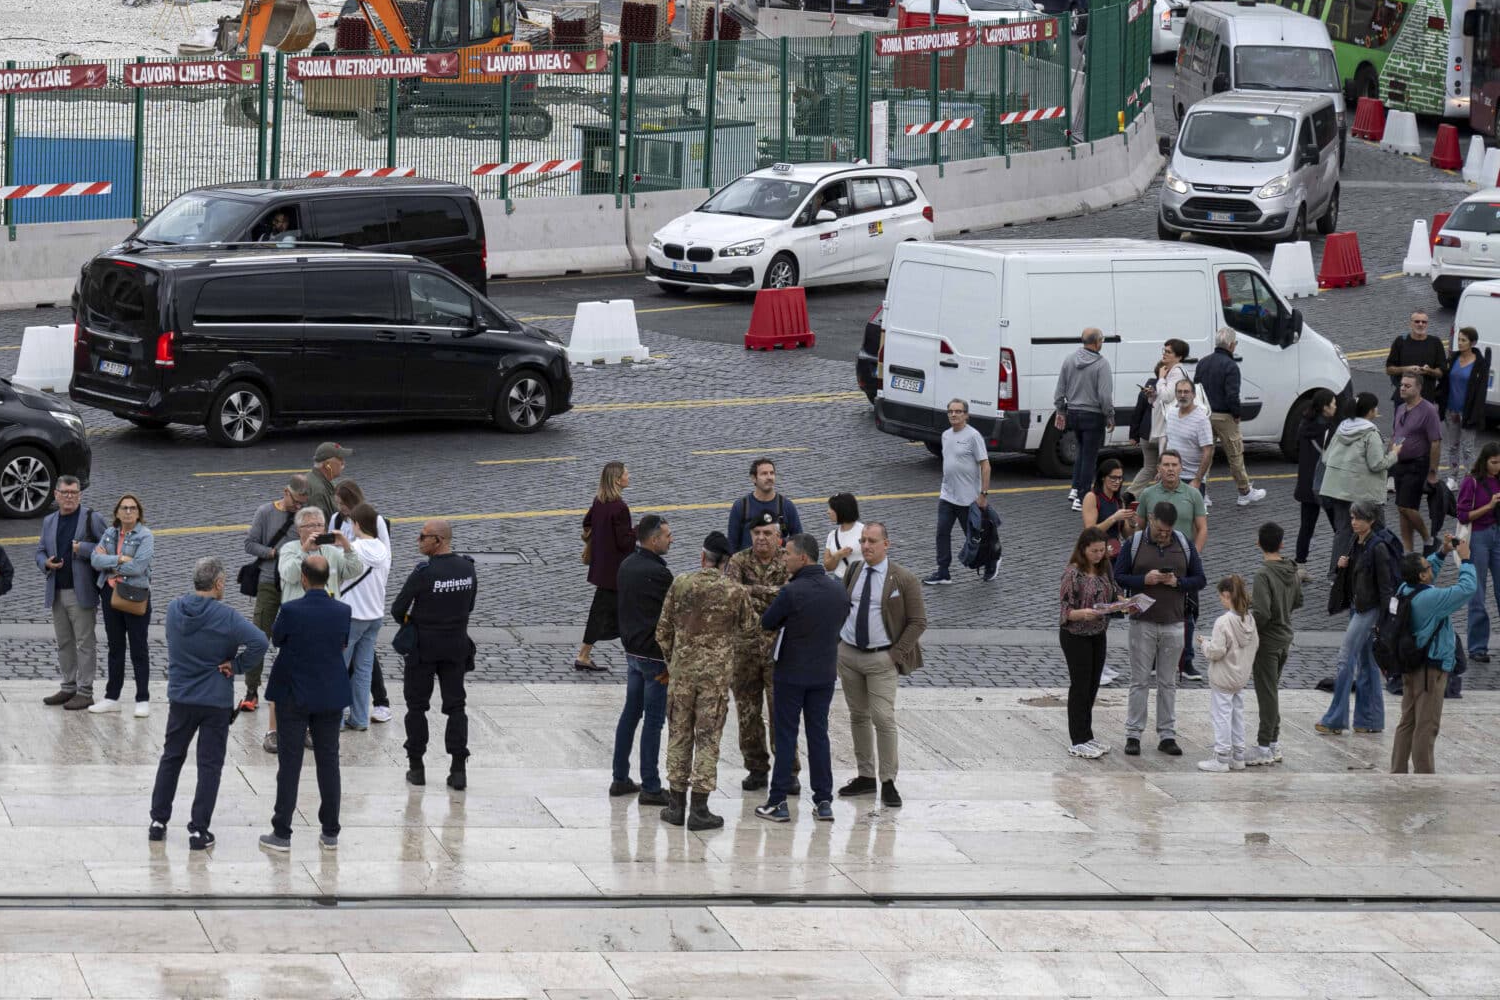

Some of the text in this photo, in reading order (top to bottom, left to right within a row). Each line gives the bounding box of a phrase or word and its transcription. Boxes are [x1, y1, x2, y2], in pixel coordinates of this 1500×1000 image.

[881, 31, 959, 53] ROMA METROPOLITANE
[985, 23, 1037, 43] LAVORI LINEA C
[298, 57, 428, 77] ROMA METROPOLITANE
[487, 53, 571, 72] LAVORI LINEA C
[132, 64, 227, 83] LAVORI LINEA C
